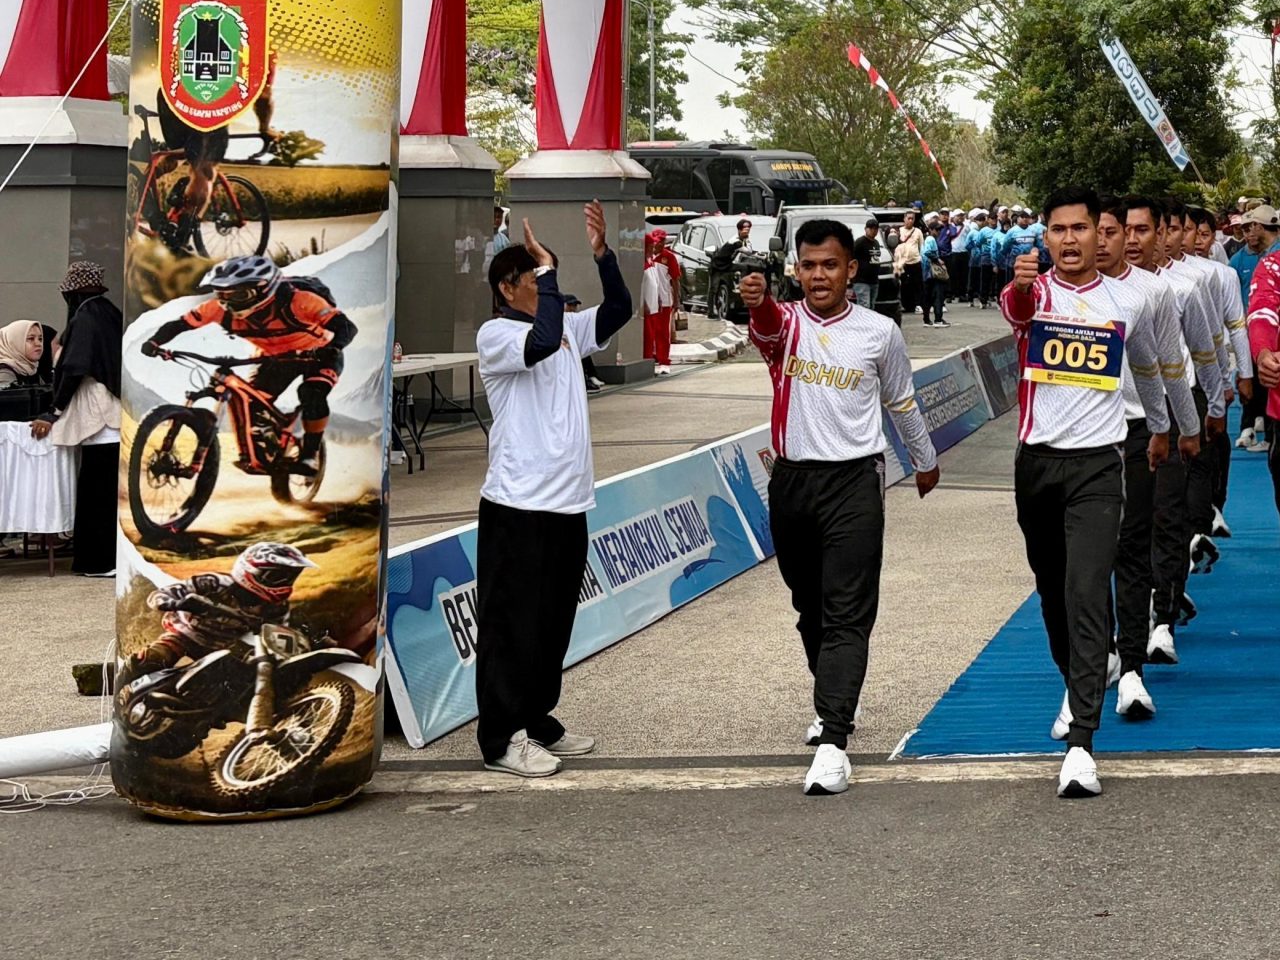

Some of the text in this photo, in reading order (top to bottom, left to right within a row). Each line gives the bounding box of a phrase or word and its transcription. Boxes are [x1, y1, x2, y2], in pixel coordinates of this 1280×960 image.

[1043, 339, 1108, 370] 005
[784, 355, 865, 391] DISHUT
[592, 514, 678, 589] MERANGKUL
[664, 500, 713, 555] SEMUA
